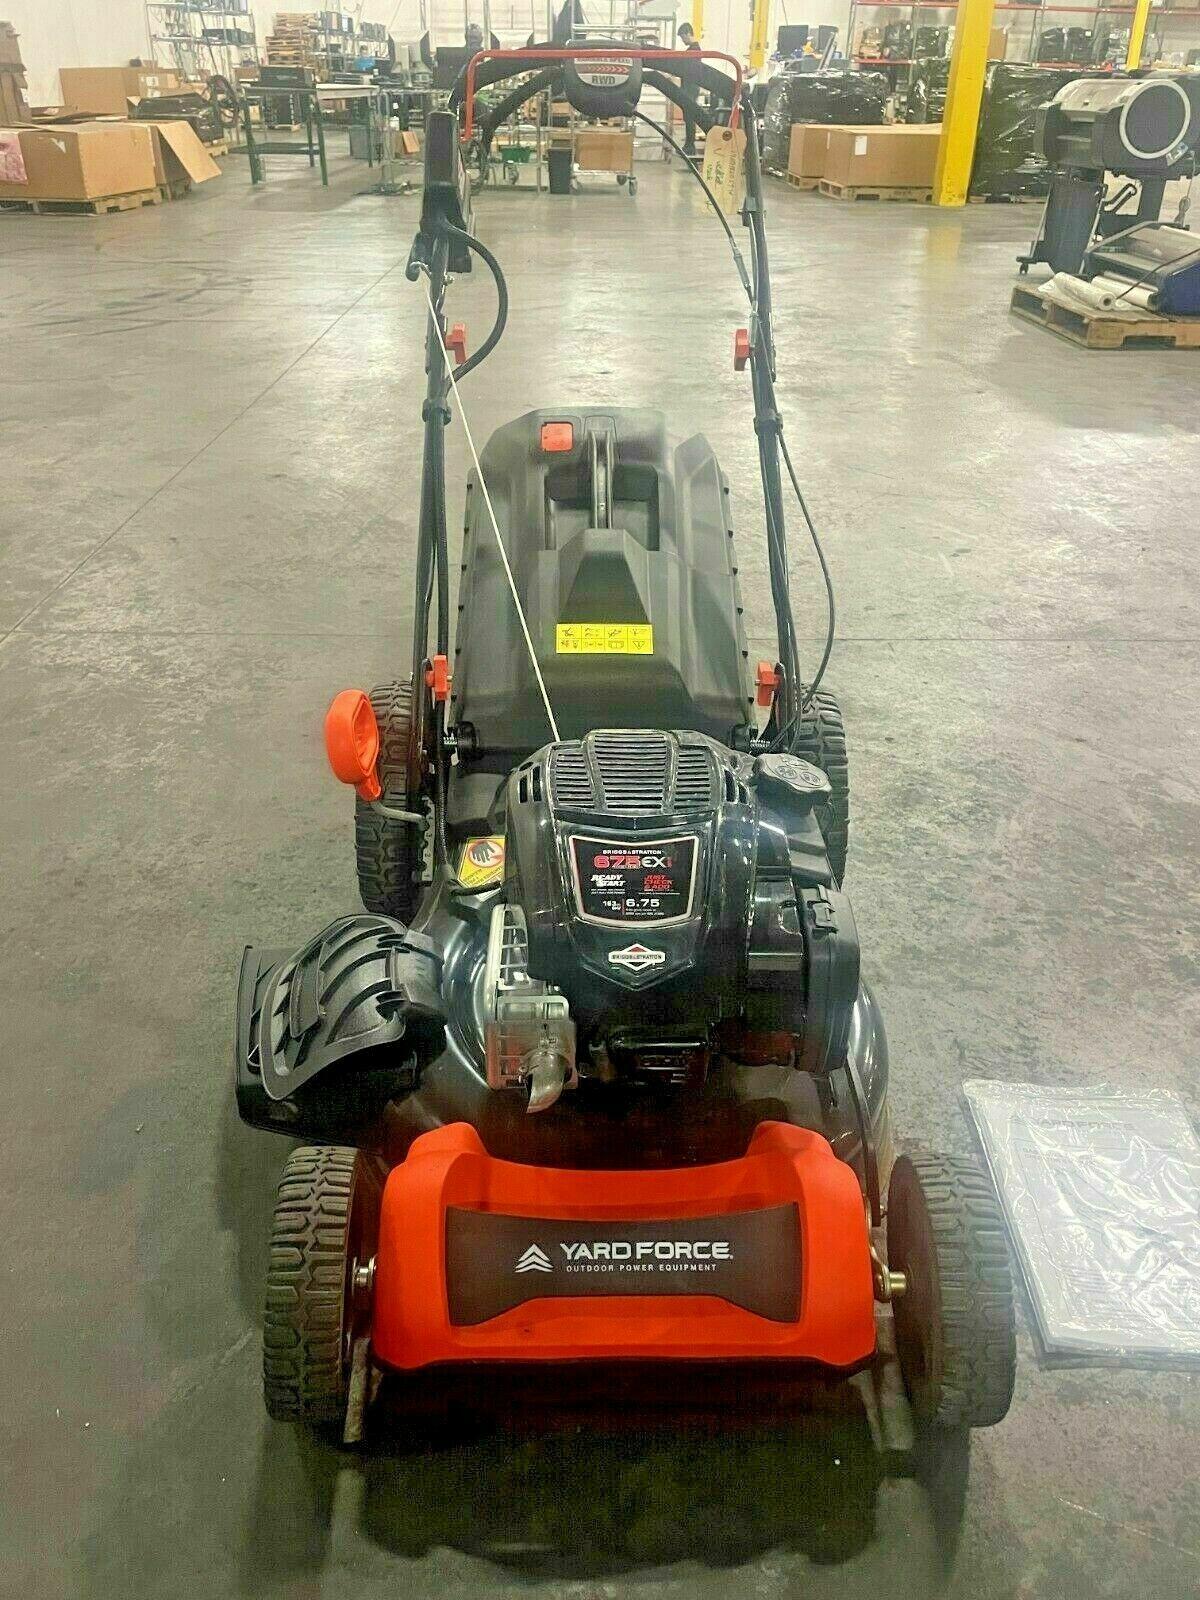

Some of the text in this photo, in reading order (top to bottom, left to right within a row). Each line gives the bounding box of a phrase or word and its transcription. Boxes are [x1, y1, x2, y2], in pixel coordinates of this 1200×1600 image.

[591, 75, 616, 84] RWD
[626, 898, 660, 907] 6.75
[560, 1242, 730, 1260] YARD FORCE
[566, 1264, 717, 1272] OUTDOOR POWER EQUIPMENT
